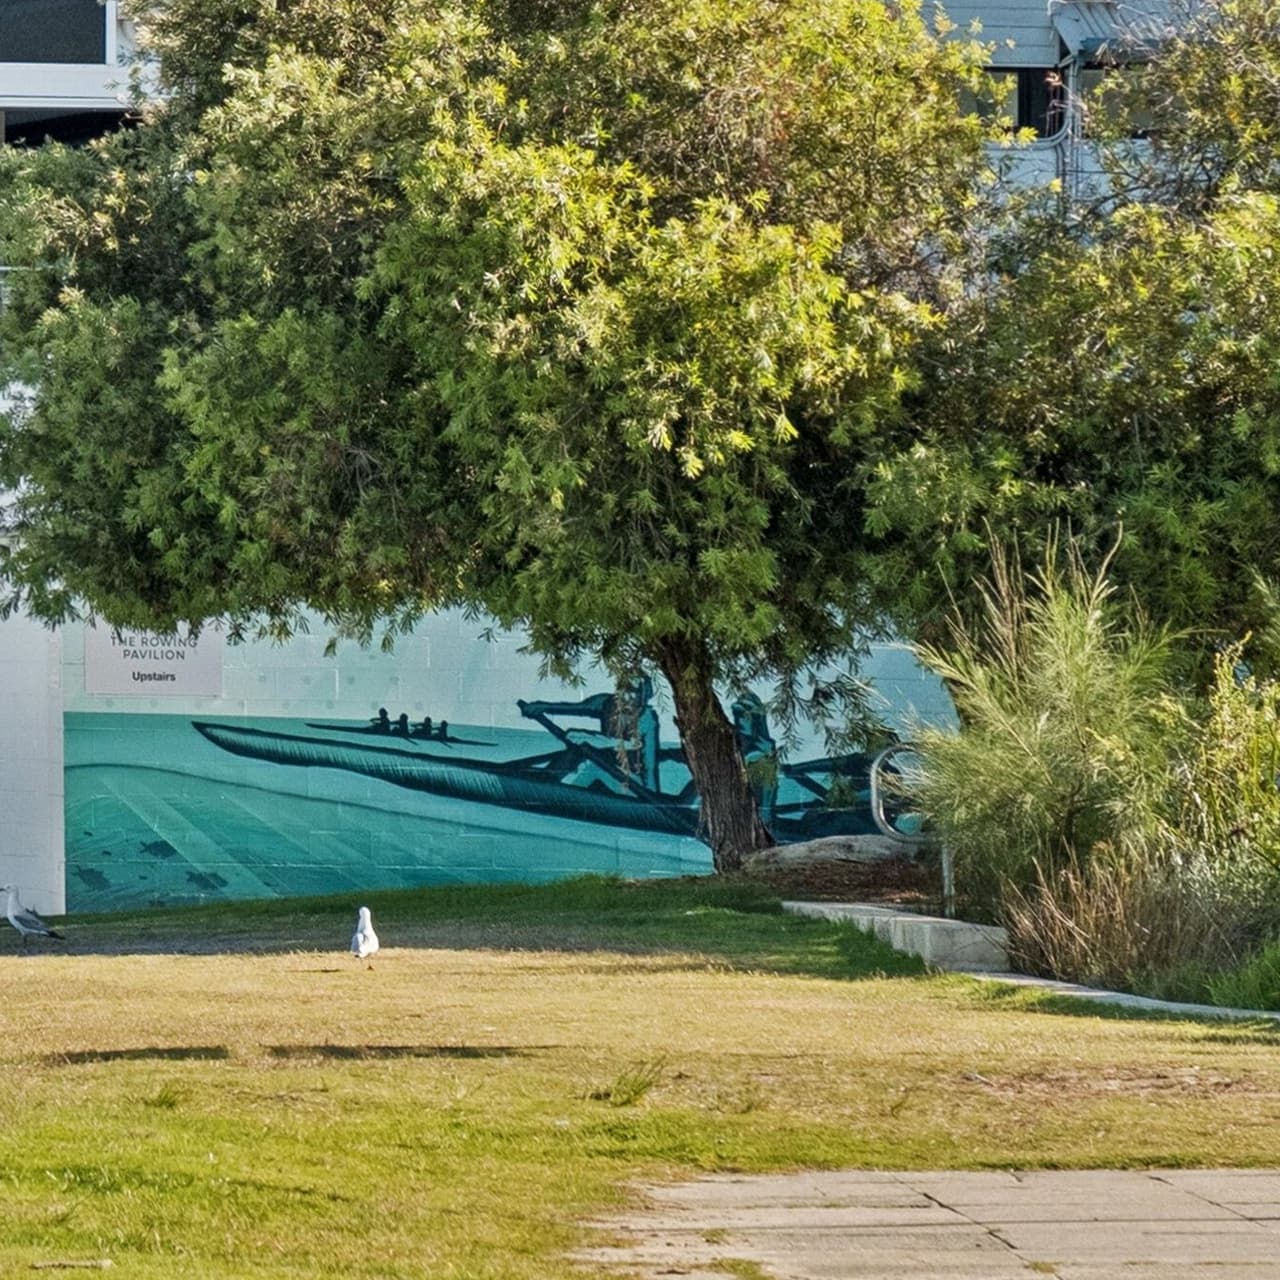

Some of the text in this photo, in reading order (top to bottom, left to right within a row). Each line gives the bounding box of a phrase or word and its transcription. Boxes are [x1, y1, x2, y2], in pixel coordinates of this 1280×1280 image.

[111, 636, 198, 648] THE ROWING
[122, 649, 185, 660] PAVILION
[132, 671, 176, 682] Upstairs
